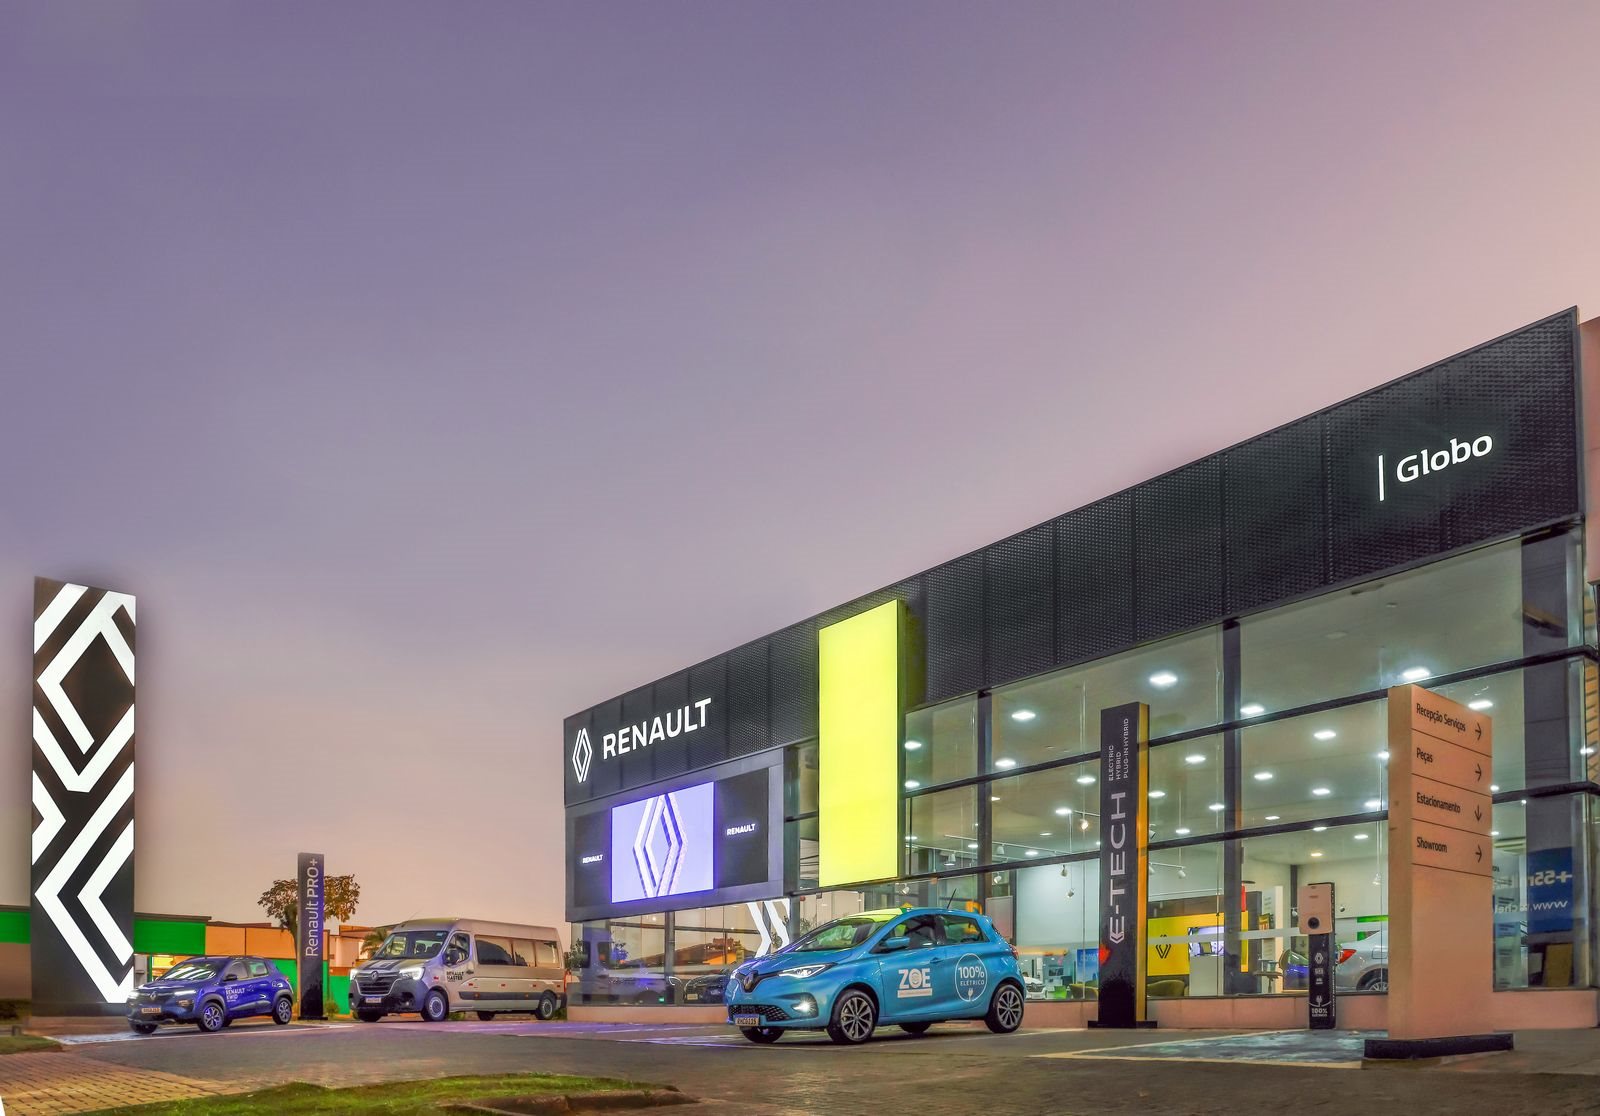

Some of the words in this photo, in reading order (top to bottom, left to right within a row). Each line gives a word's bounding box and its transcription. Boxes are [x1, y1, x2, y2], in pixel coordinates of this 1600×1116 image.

[1396, 435, 1493, 483] Globo
[1416, 703, 1443, 722] Recepção
[1443, 714, 1467, 732] Serviços
[603, 697, 712, 760] RENAULT
[1416, 747, 1433, 764] Peças
[1416, 792, 1461, 813] Estacionamento
[726, 823, 756, 836] RENAULT
[1416, 836, 1448, 853] Showroom
[582, 854, 603, 864] RENAULT
[1110, 792, 1126, 944] E-TECH
[306, 858, 319, 898] PRO+
[305, 901, 319, 957] Renault
[898, 968, 931, 989] ZOE
[958, 966, 985, 979] 100%
